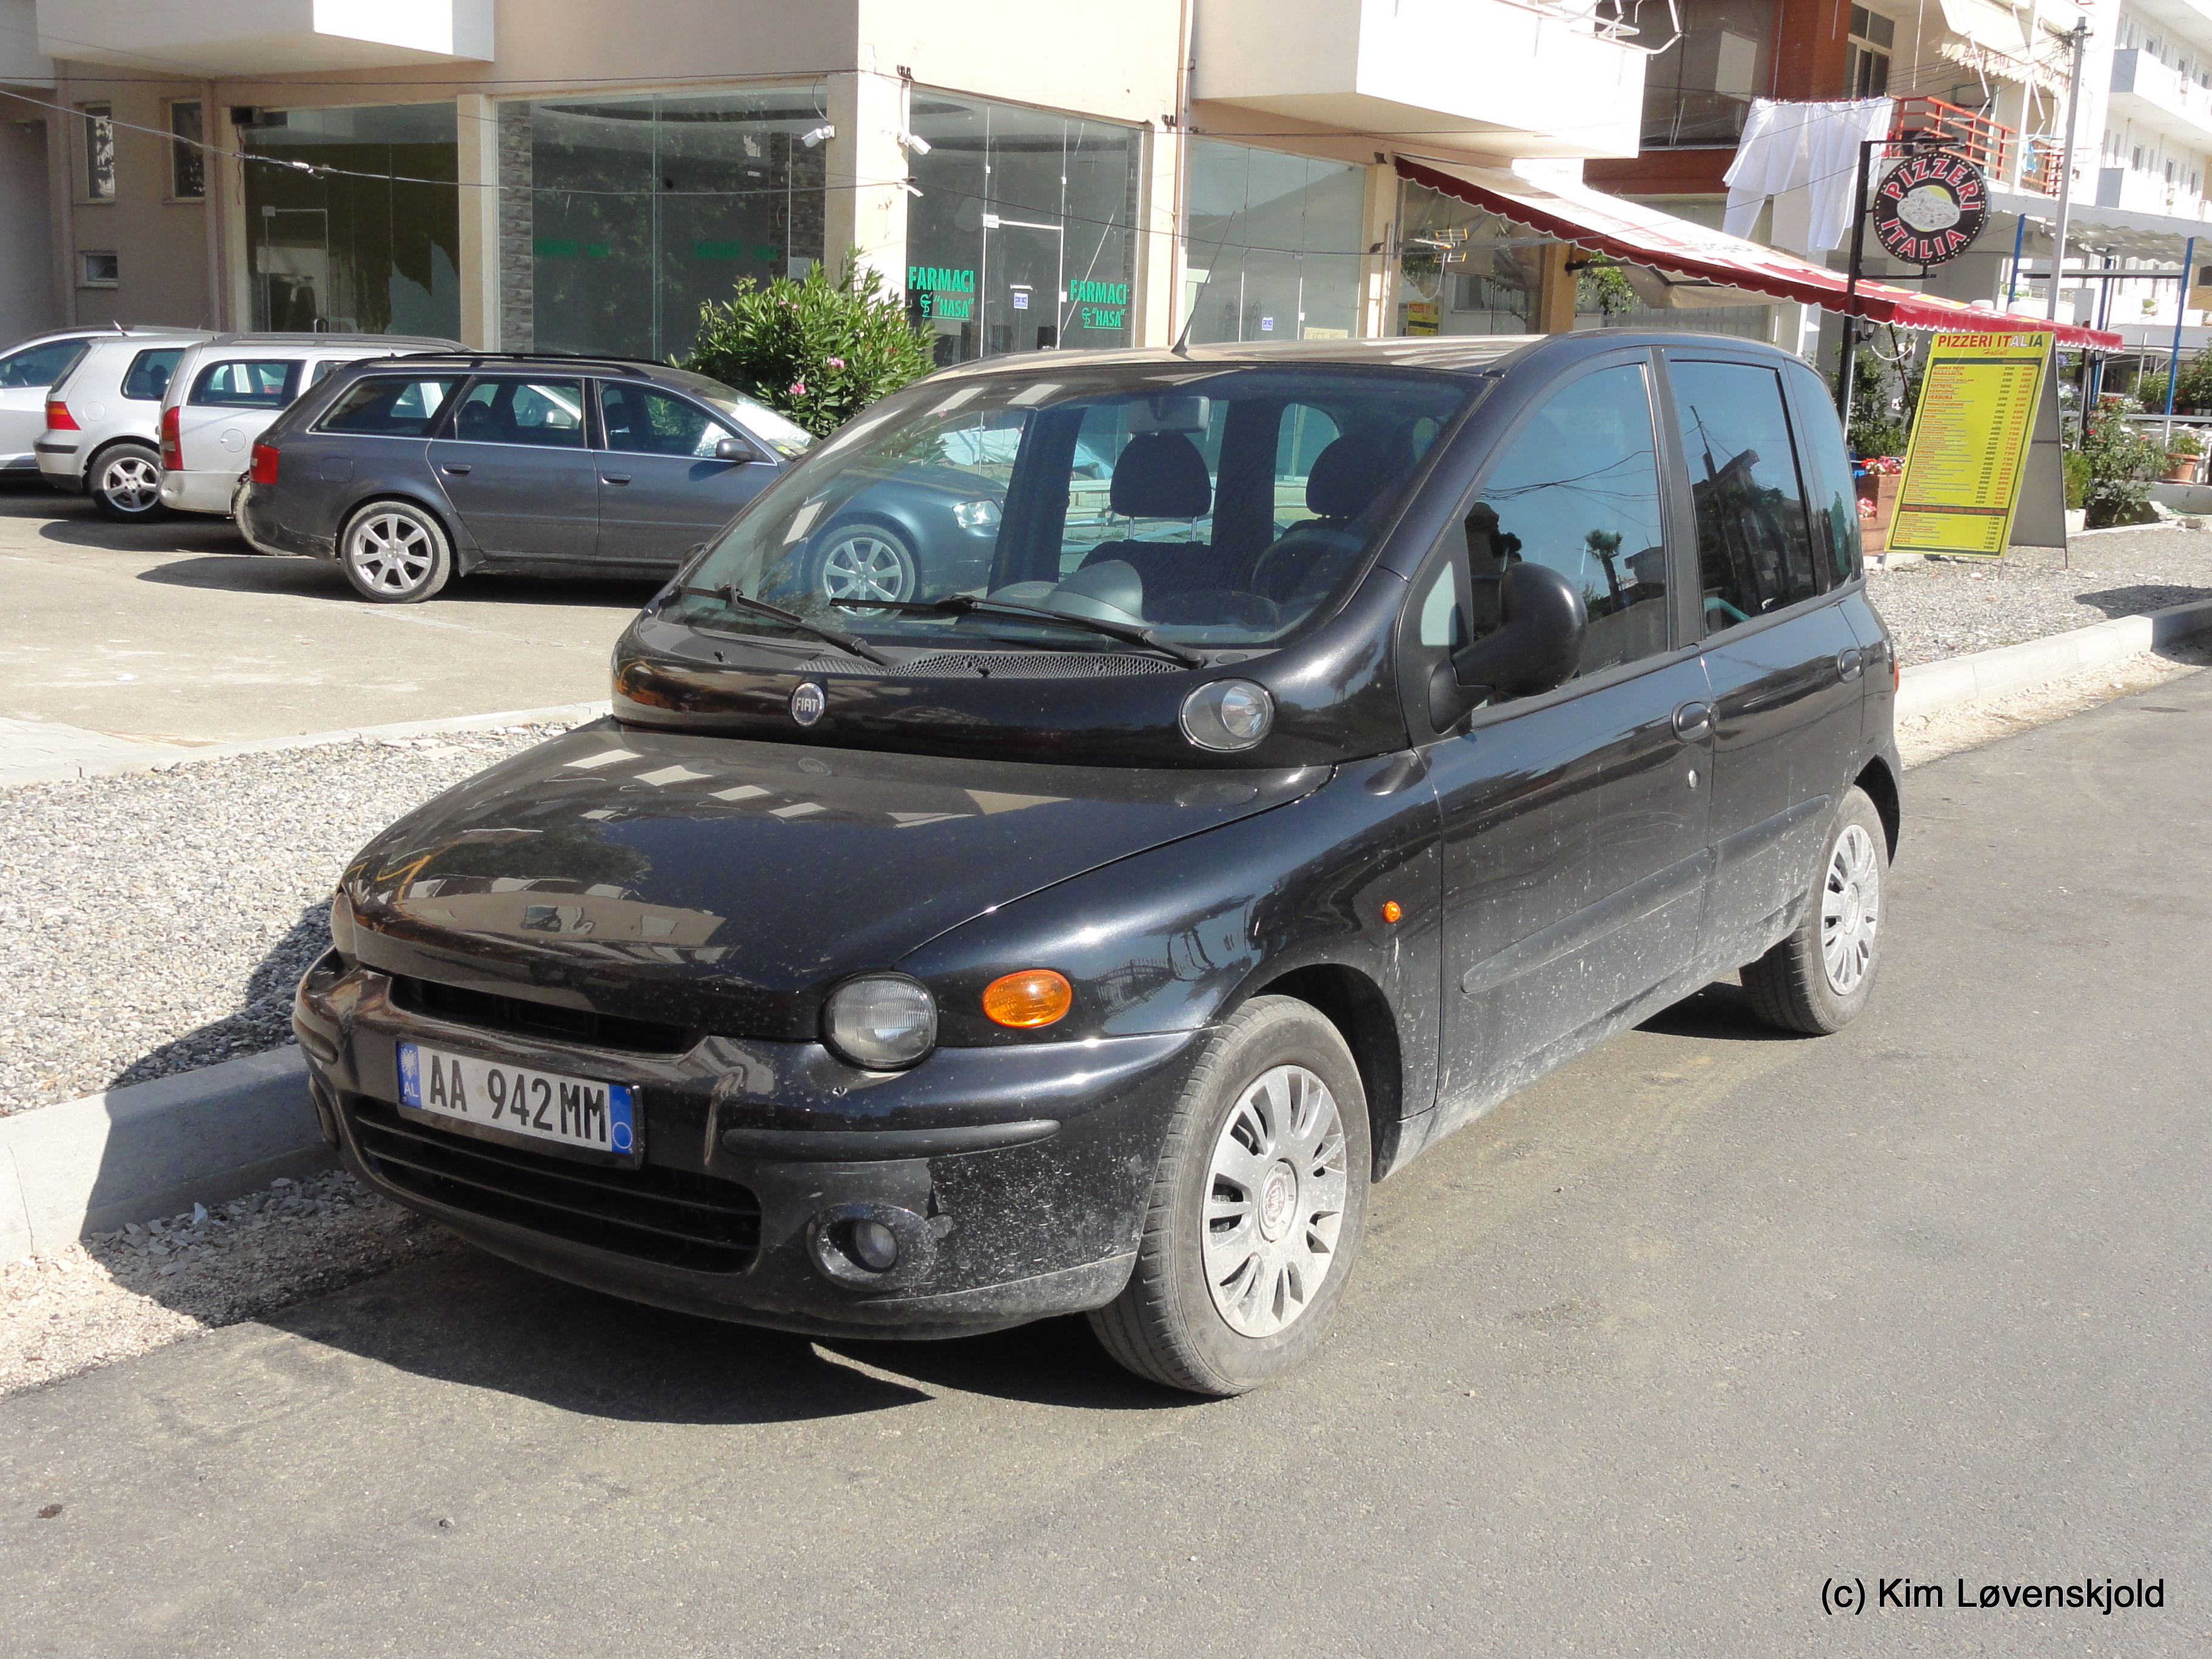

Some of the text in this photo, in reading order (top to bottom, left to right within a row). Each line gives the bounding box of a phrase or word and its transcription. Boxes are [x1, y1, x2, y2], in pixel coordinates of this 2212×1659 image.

[1885, 158, 1980, 210] PIZZERI
[1880, 219, 1965, 259] ITALIA
[908, 266, 974, 293] FARMACI
[1070, 280, 1127, 305] FARMACI
[1937, 334, 2043, 347] PIZZERI ITALIA
[796, 697, 818, 712] FIAT
[403, 1081, 418, 1098] AL
[429, 1054, 468, 1112] AA
